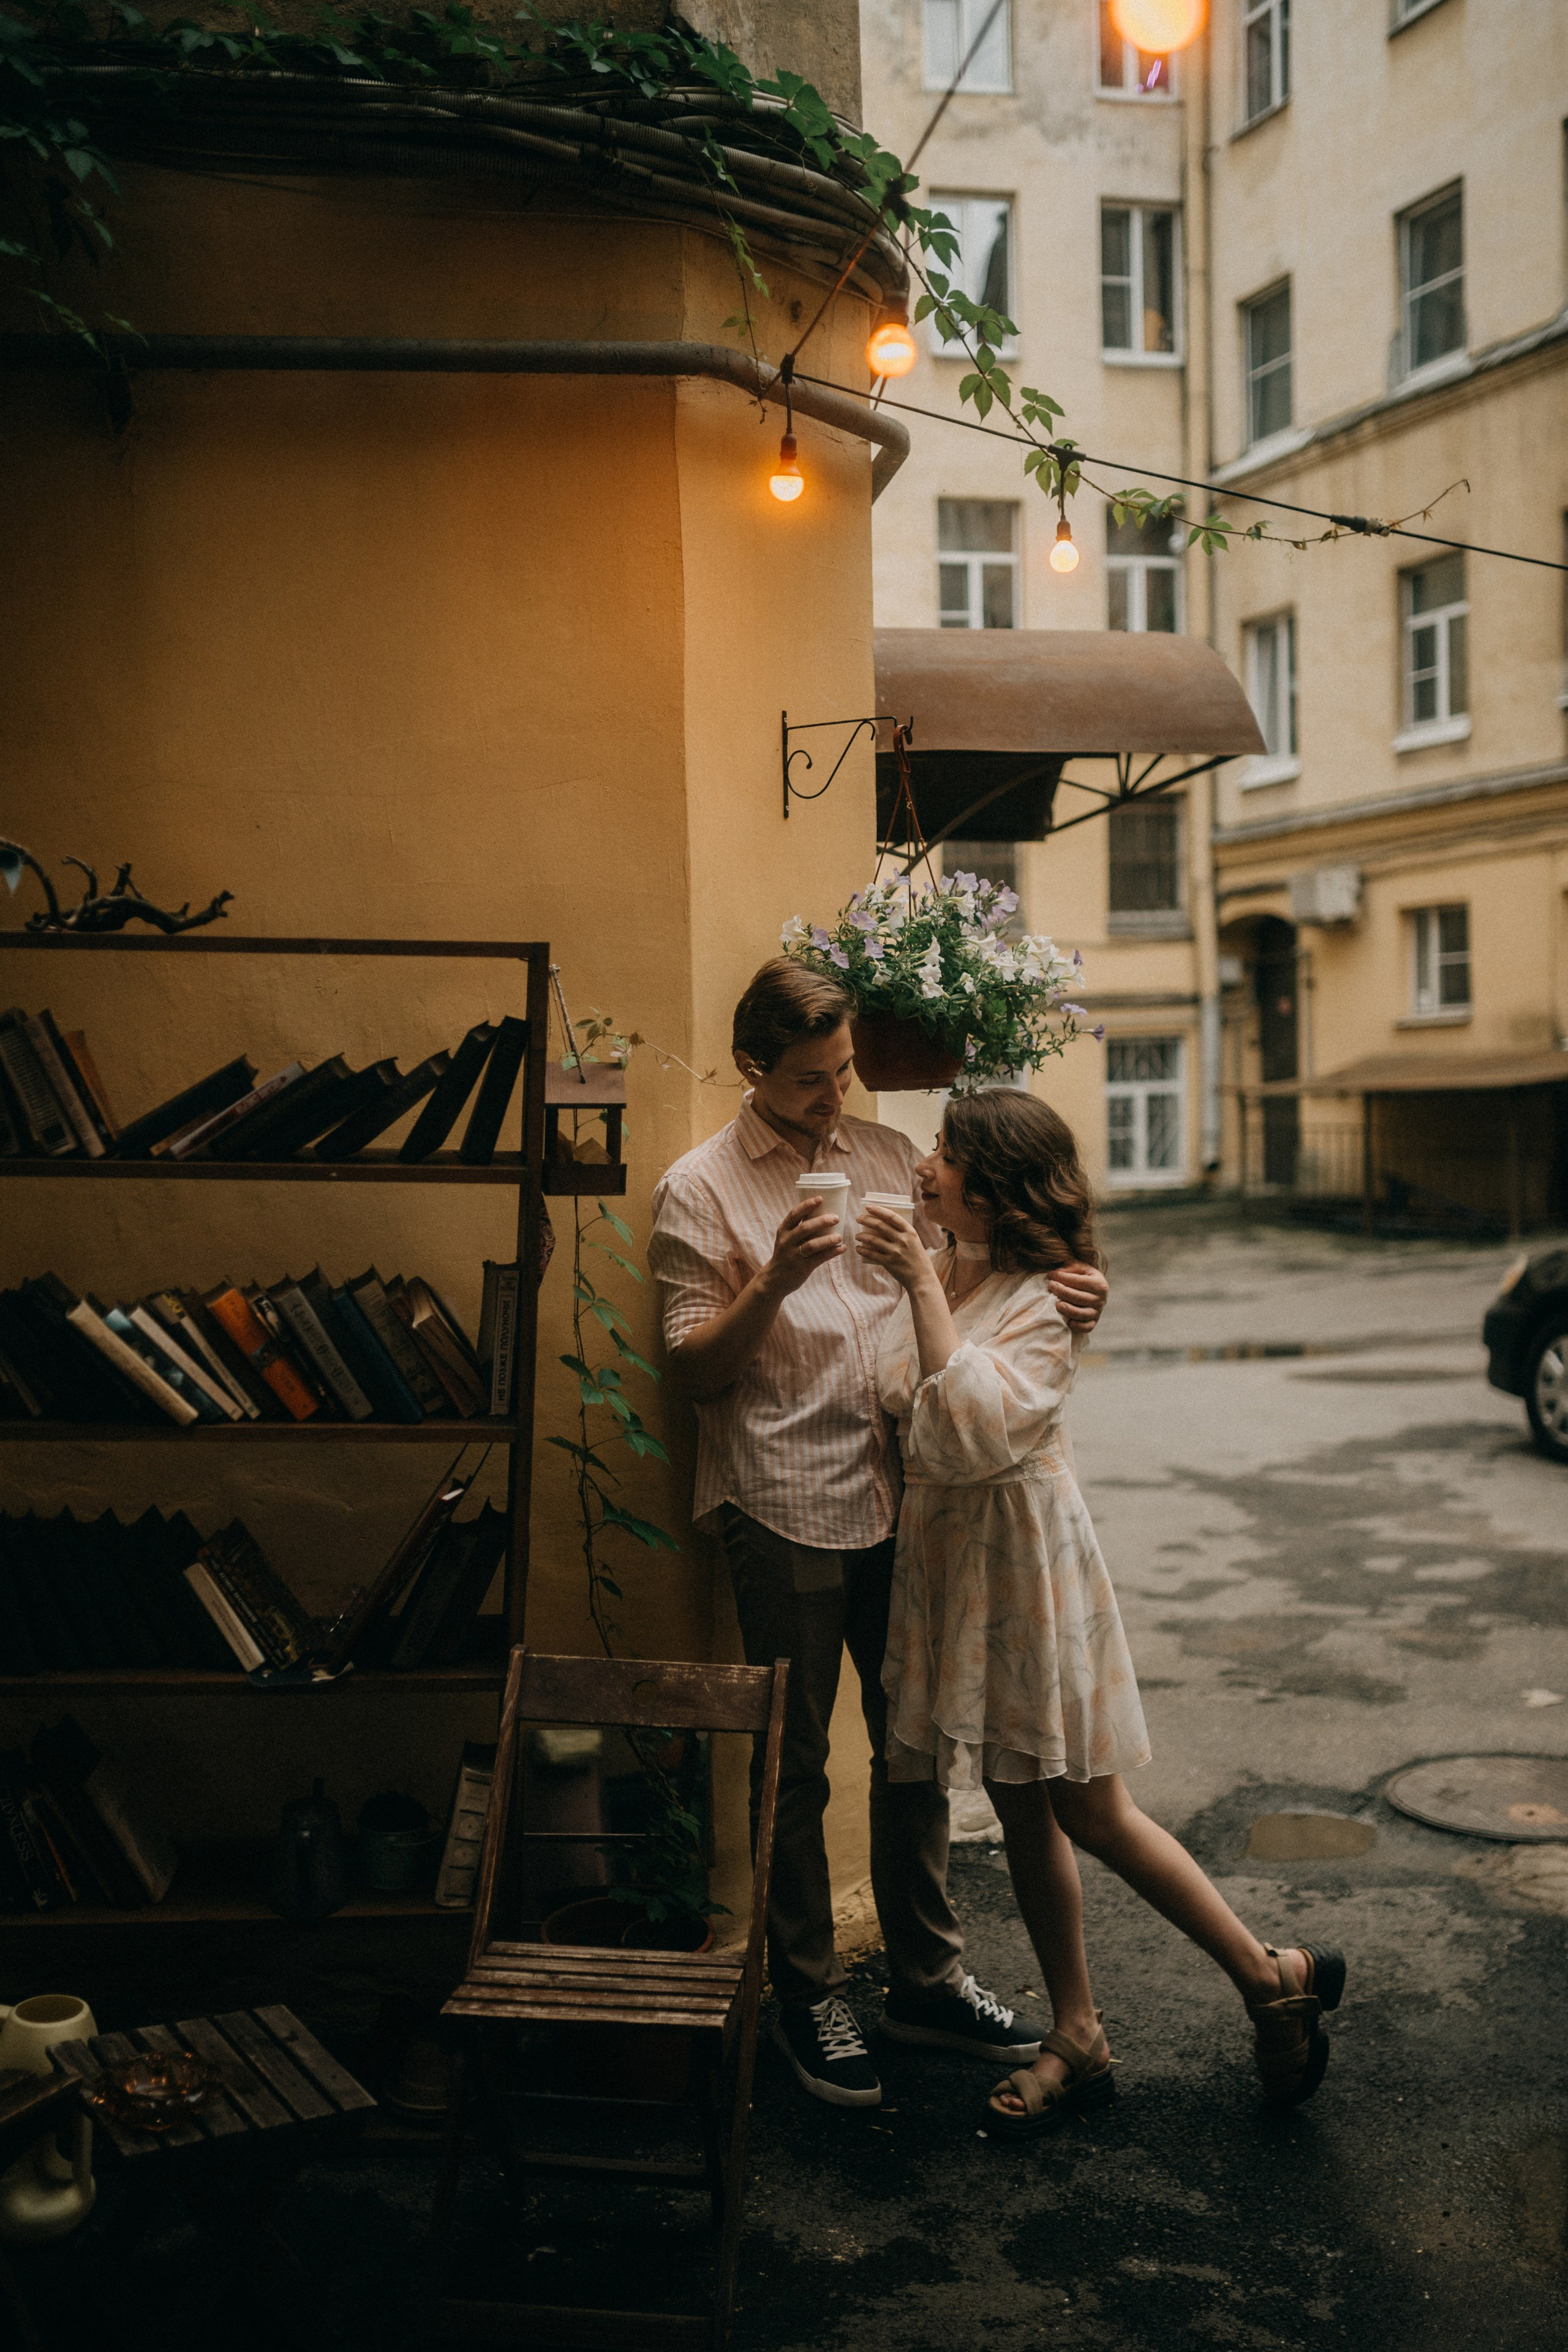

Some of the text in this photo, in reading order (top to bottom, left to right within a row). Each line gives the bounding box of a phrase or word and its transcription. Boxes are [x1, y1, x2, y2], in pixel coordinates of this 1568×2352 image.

[500, 1300, 510, 1350] ПОЛУНОЧИ
[498, 1353, 508, 1386] ПОЗЖЕ
[497, 1389, 504, 1401] НЕ
